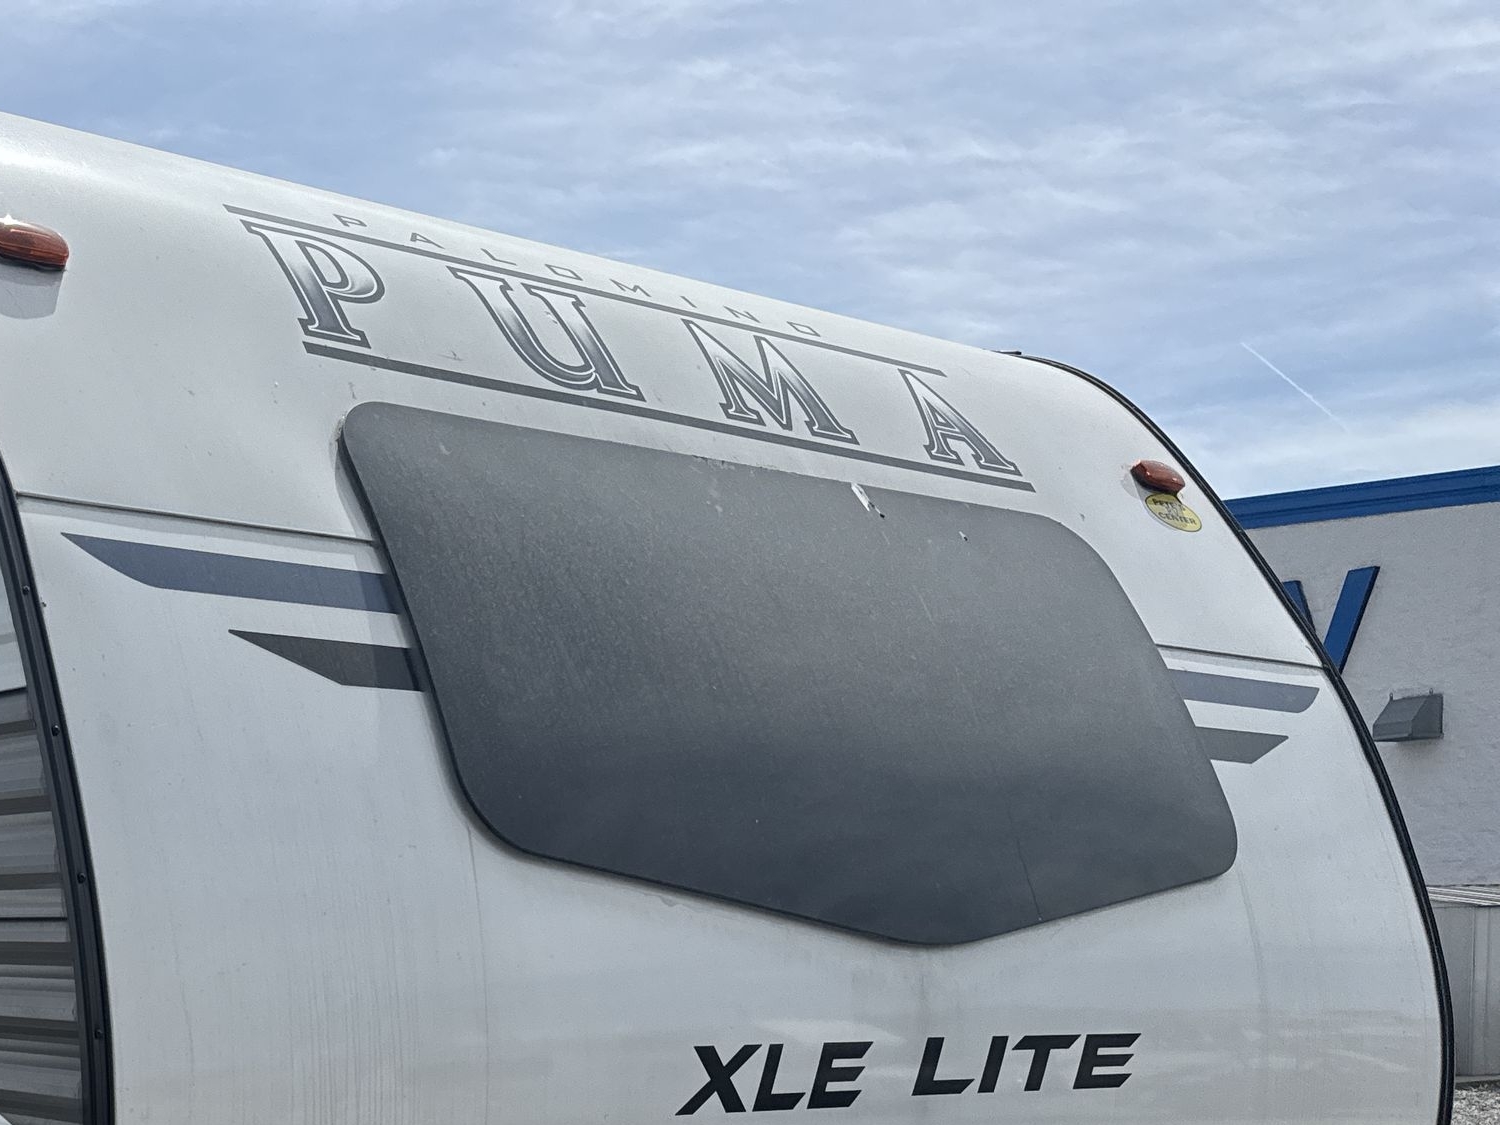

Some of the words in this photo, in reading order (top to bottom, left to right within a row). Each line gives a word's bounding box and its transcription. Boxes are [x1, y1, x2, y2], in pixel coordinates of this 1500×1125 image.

[332, 213, 823, 338] PALOMINO
[239, 218, 1023, 478] PUMA
[675, 1040, 874, 1117] XLE
[911, 1032, 1142, 1097] LITE
